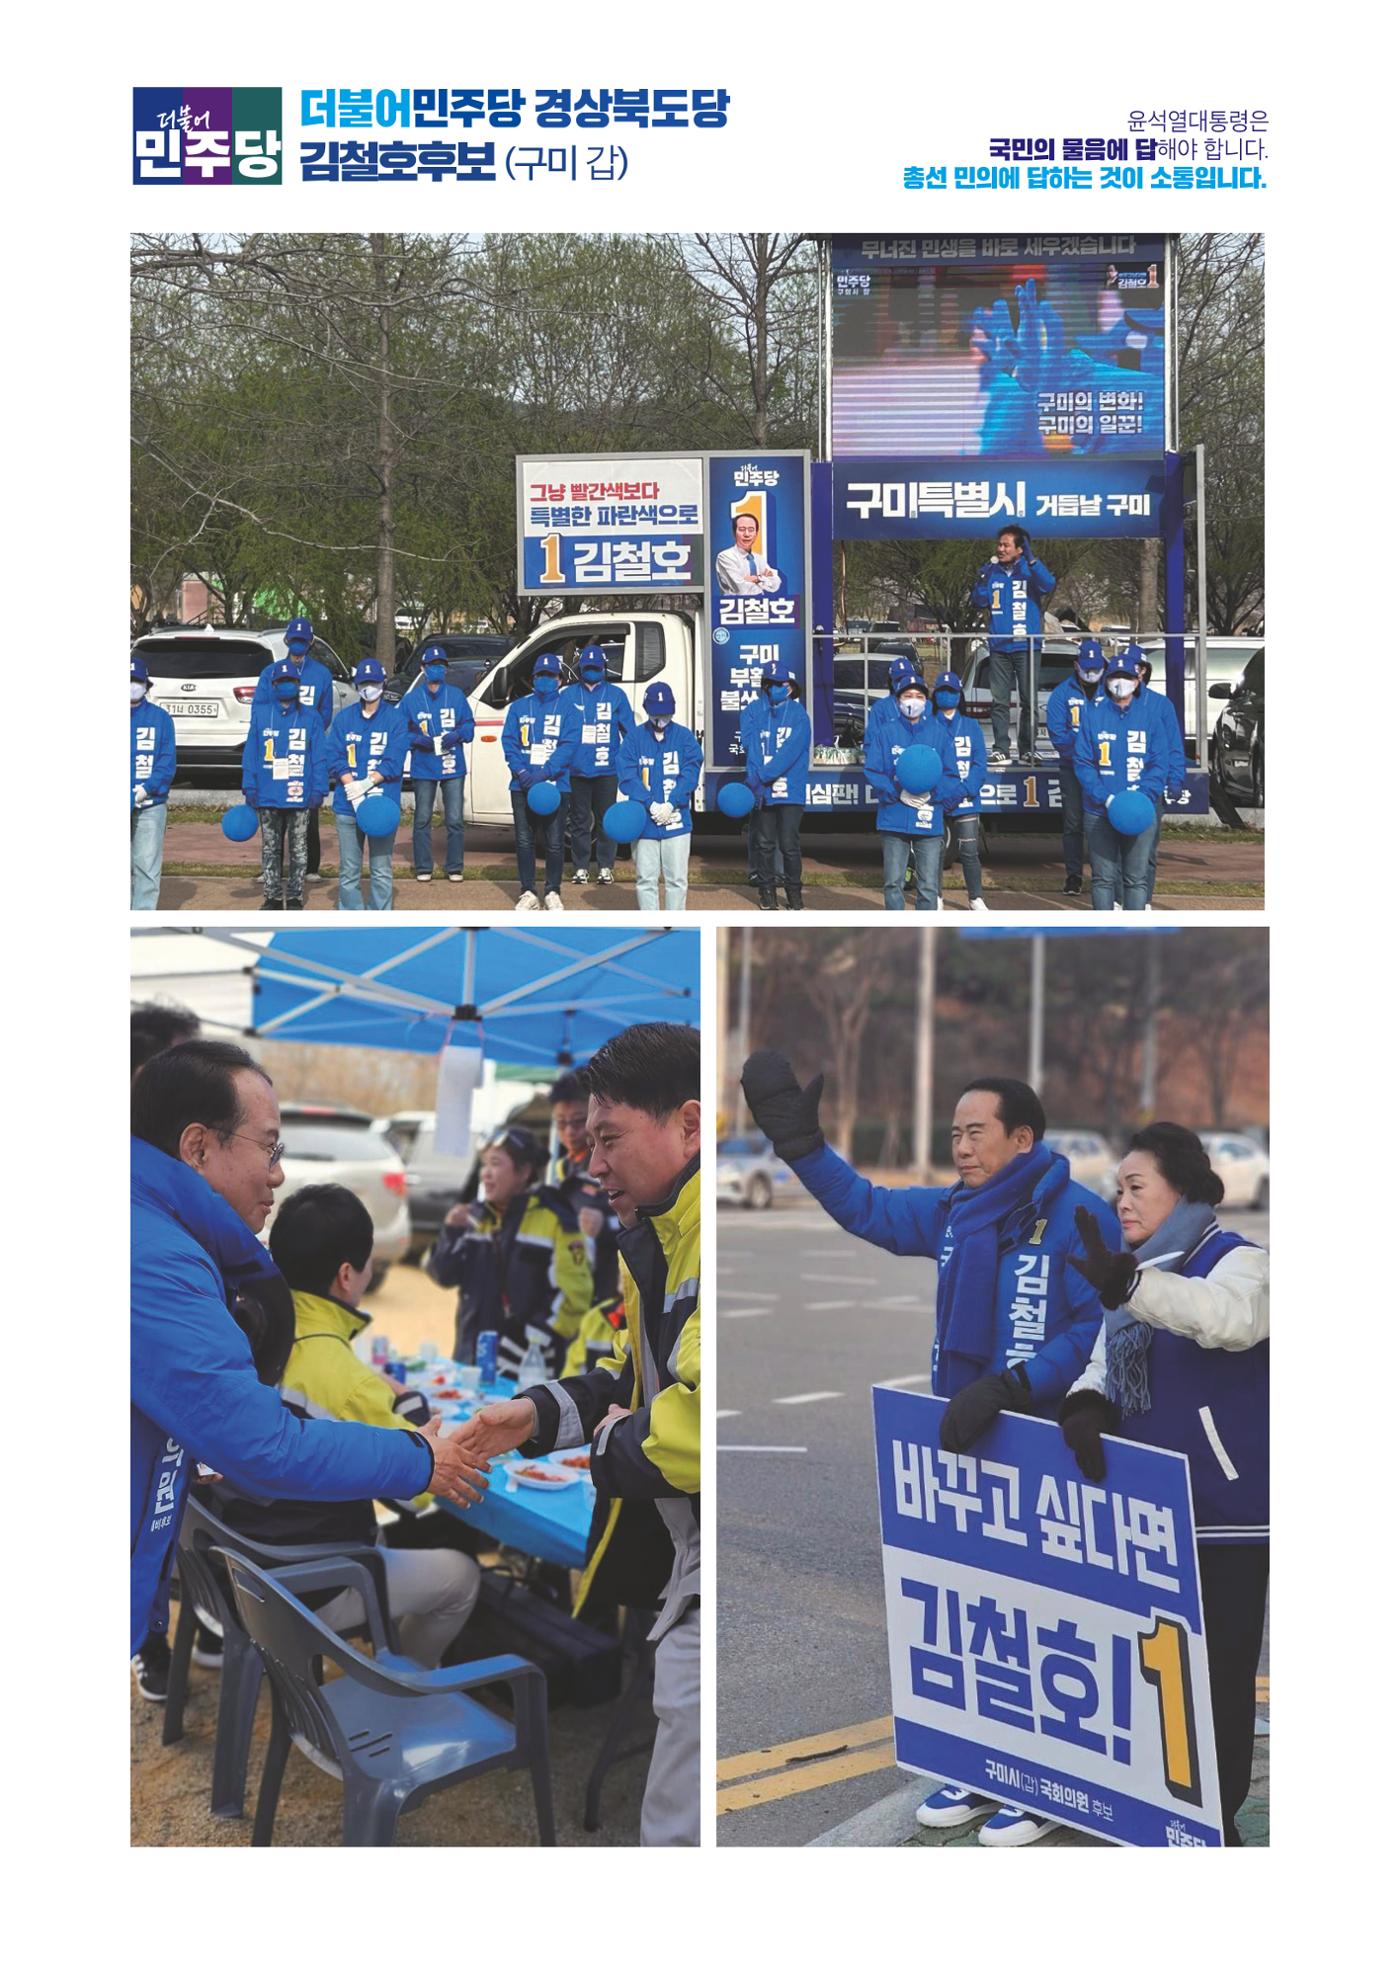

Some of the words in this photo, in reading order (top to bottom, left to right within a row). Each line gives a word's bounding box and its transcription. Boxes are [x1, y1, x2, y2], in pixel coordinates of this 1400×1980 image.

[861, 239, 918, 260] 무너진
[922, 238, 977, 259] 민생을
[982, 237, 1019, 257] 바로
[1024, 234, 1136, 256] 세우겠습니다
[837, 275, 871, 288] 민주당
[1037, 392, 1093, 412] 구미의
[1098, 391, 1144, 412] 변화!
[1038, 415, 1094, 435] 구미의
[1099, 415, 1143, 434] 일꾼!
[733, 470, 780, 487] 민주당
[530, 483, 566, 502] 그냥
[570, 482, 660, 502] 빨간색보다
[846, 481, 1026, 519] 구미특별시
[1036, 494, 1102, 517] 거듭날
[1106, 494, 1150, 517] 구미
[530, 505, 592, 528] 특별한
[597, 504, 699, 527] 파란색으로
[539, 533, 566, 584] 1
[573, 541, 692, 583] 김철호
[719, 598, 796, 625] 김철호
[991, 589, 1001, 609] 1
[739, 644, 780, 665] 구미
[187, 704, 213, 715] 0355
[439, 708, 457, 775] 김호
[595, 702, 612, 767] 김철호
[264, 738, 275, 761] 1
[1098, 741, 1112, 767] 1
[286, 728, 306, 803] 김철호
[805, 784, 859, 805] 심판!
[980, 784, 1017, 805] 으로
[1023, 775, 1041, 808] 1
[1028, 1218, 1048, 1245] 1
[892, 1439, 1029, 1547] 바꾸고
[1035, 1474, 1181, 1594] 싶다면
[900, 1577, 1132, 1767] 김철호!
[1137, 1615, 1203, 1809] 1
[984, 1759, 1039, 1797] 구미시(갑)
[1040, 1778, 1090, 1815] 국회의원
[1092, 1799, 1115, 1822] 후보
